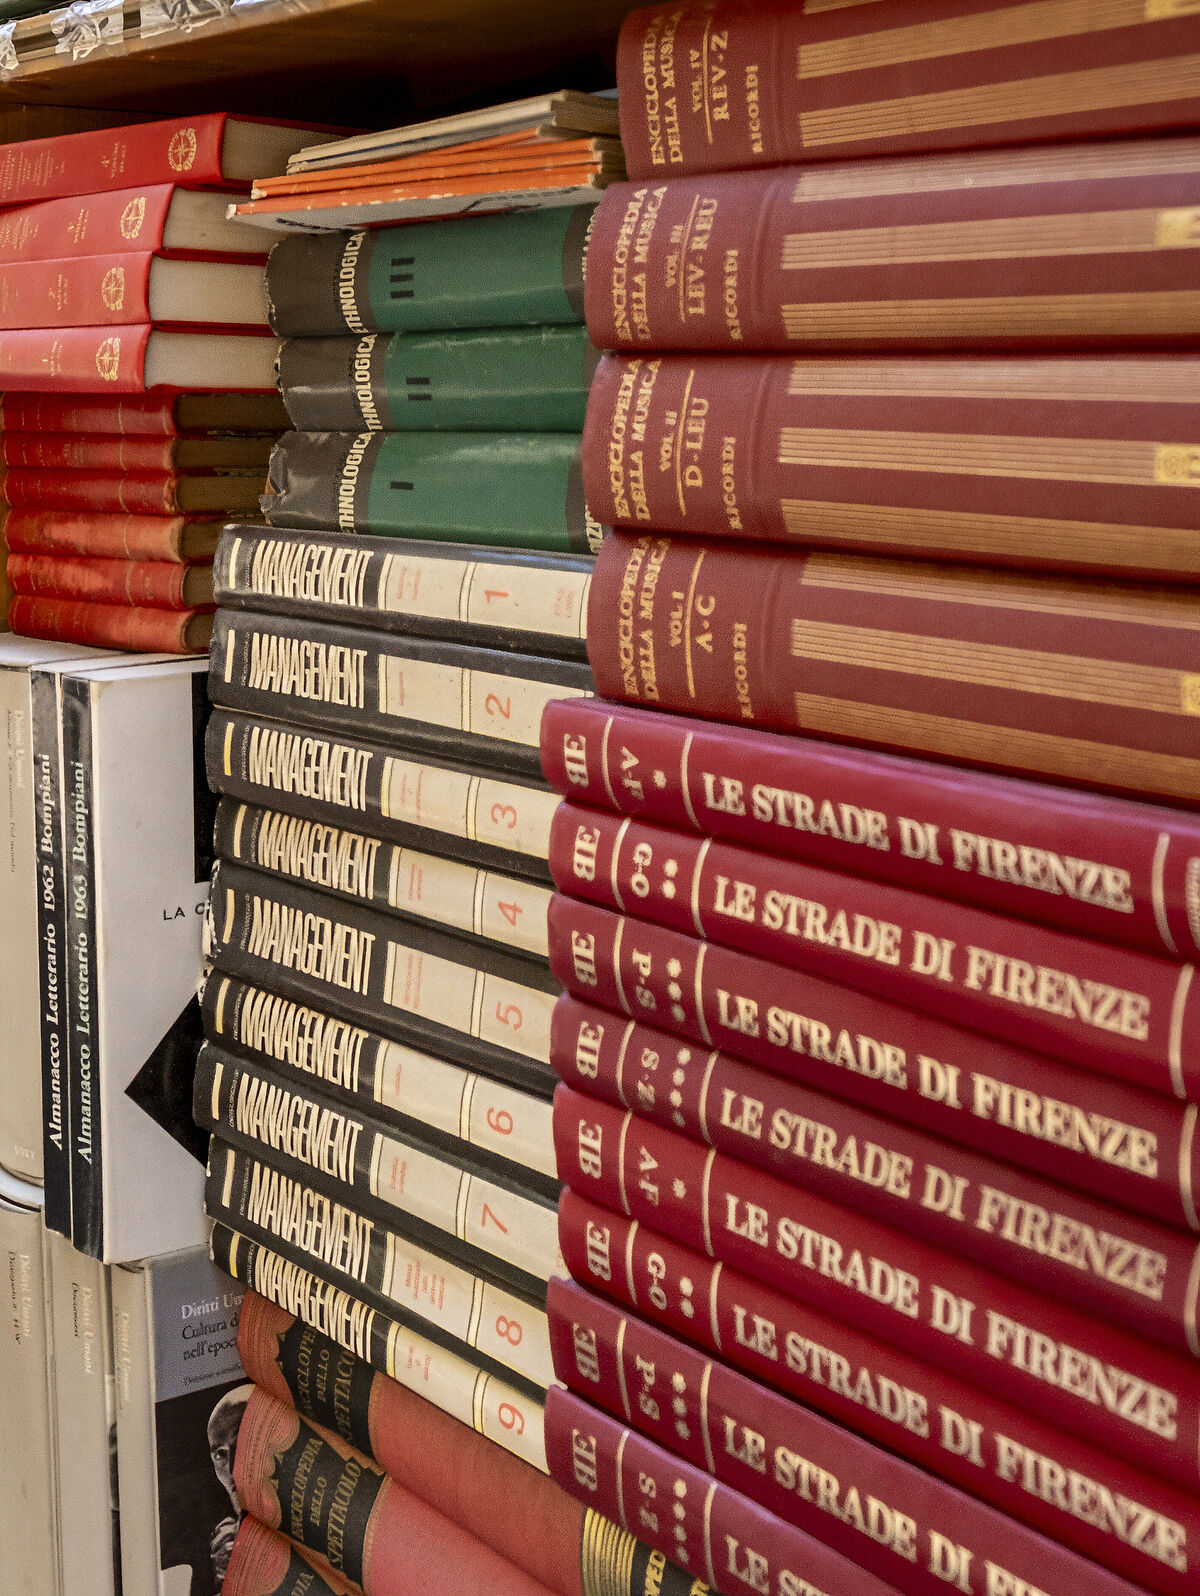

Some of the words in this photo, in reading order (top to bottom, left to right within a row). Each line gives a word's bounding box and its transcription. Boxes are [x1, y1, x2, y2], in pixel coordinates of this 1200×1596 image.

[664, 100, 683, 164] DELLA
[746, 65, 764, 153] RICORDI
[631, 186, 668, 268] MUSICA
[636, 274, 655, 342] DELLA
[723, 249, 743, 341] RICORDI
[354, 334, 383, 431] THNOLOGICA
[631, 359, 662, 441] MUSICA
[338, 432, 377, 534] THNOLOGICA
[629, 451, 651, 520] DELLA
[722, 437, 743, 530] RICORDI
[252, 539, 374, 608] MANAGEMENT
[485, 589, 509, 603] 1
[639, 538, 672, 630] MUSICA
[249, 632, 367, 708] MANAGEMENT
[485, 693, 511, 719] 2
[635, 635, 660, 701] DELLA
[732, 622, 755, 719] RICORDI
[39, 754, 55, 853] Bompiani
[72, 762, 89, 863] Bompiani
[249, 727, 373, 812] MANAGEMENT
[258, 810, 381, 900] MANAGEMENT
[490, 802, 517, 829] 3
[702, 773, 746, 815] LE
[752, 783, 889, 850] STRADE
[899, 817, 944, 866] DI
[950, 828, 1135, 914] FIRENZE
[41, 866, 55, 910] 1962
[72, 875, 89, 919] 1963
[163, 907, 185, 921] LA
[498, 901, 523, 926] 4
[44, 923, 59, 1026] Letterario
[73, 932, 90, 1035] Letterario
[248, 896, 376, 995] MANAGEMENT
[713, 876, 757, 921] LE
[762, 890, 902, 967] STRADE
[911, 929, 957, 982] DI
[966, 944, 1151, 1042] FIRENZE
[241, 987, 368, 1092] MANAGEMENT
[496, 1001, 522, 1030] 5
[49, 1033, 63, 1150] Almanacco
[77, 1044, 93, 1164] Almanacco
[237, 1073, 363, 1185] MANAGEMENT
[487, 1107, 513, 1135] 6
[716, 989, 760, 1038] LE
[766, 1005, 908, 1089] STRADE
[917, 1053, 960, 1112] DI
[971, 1071, 1159, 1180] FIRENZE
[248, 1161, 374, 1283] MANAGEMENT
[481, 1204, 508, 1234] 7
[720, 1088, 763, 1140] LE
[769, 1107, 912, 1199] STRADE
[922, 1165, 968, 1222] DI
[976, 1184, 1167, 1303] FIRENZE
[182, 1319, 228, 1340] Cultura
[183, 1338, 238, 1361] nell'epoc
[254, 1246, 375, 1364] MANAGEMENT
[495, 1315, 522, 1346] 8
[724, 1193, 769, 1248] LE
[776, 1217, 920, 1320] STRADE
[931, 1283, 975, 1346] DI
[985, 1308, 1179, 1441] FIRENZE
[498, 1402, 525, 1436] 9
[732, 1304, 778, 1362] LE
[785, 1331, 930, 1439] STRADE
[939, 1404, 986, 1469] DI
[994, 1431, 1188, 1574] FIRENZE
[722, 1415, 768, 1476] LE
[773, 1445, 918, 1563] STRADE
[928, 1529, 975, 1595] DI
[724, 1533, 770, 1595] LE
